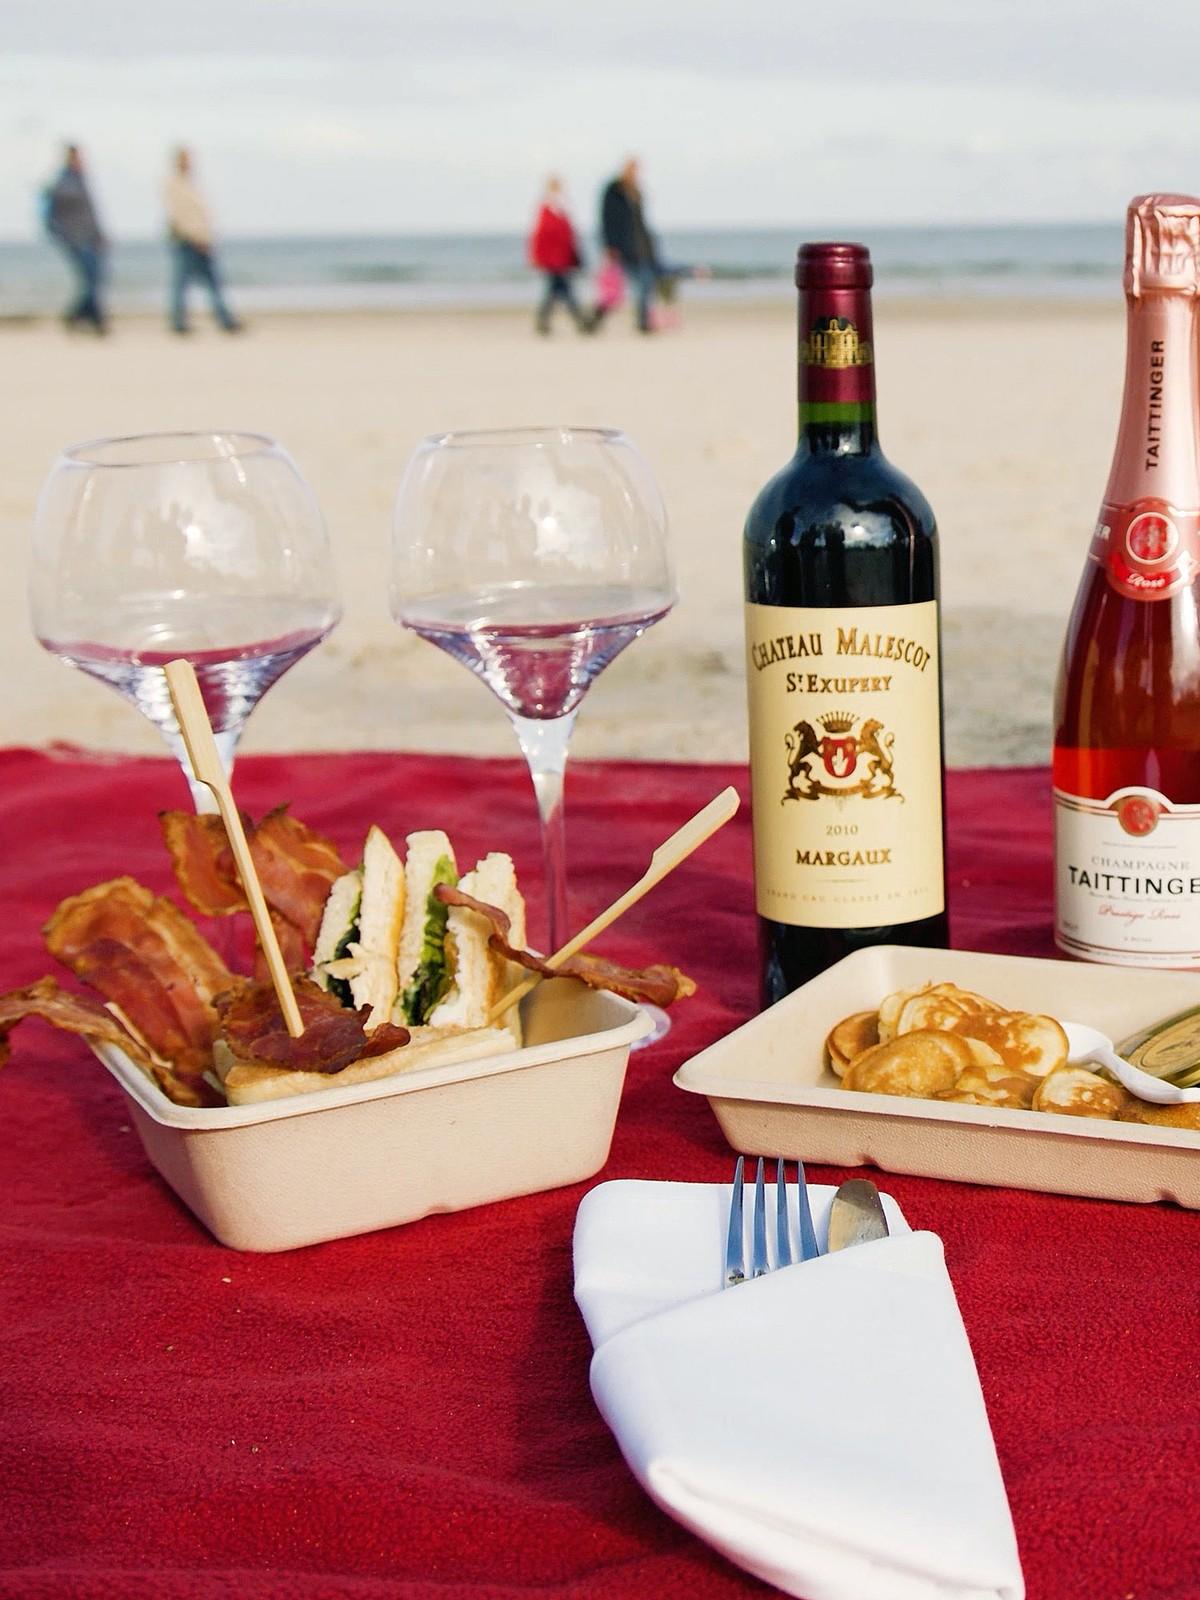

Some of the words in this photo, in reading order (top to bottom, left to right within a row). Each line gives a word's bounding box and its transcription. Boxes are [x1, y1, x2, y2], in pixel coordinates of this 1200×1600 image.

[1145, 340, 1165, 471] TAITTINGER
[751, 633, 823, 671] CHATEAU
[836, 627, 931, 672] MALESCOT
[826, 824, 859, 837] 2010
[795, 848, 892, 866] MARGAUX
[1090, 855, 1190, 871] CHAMPAGNE
